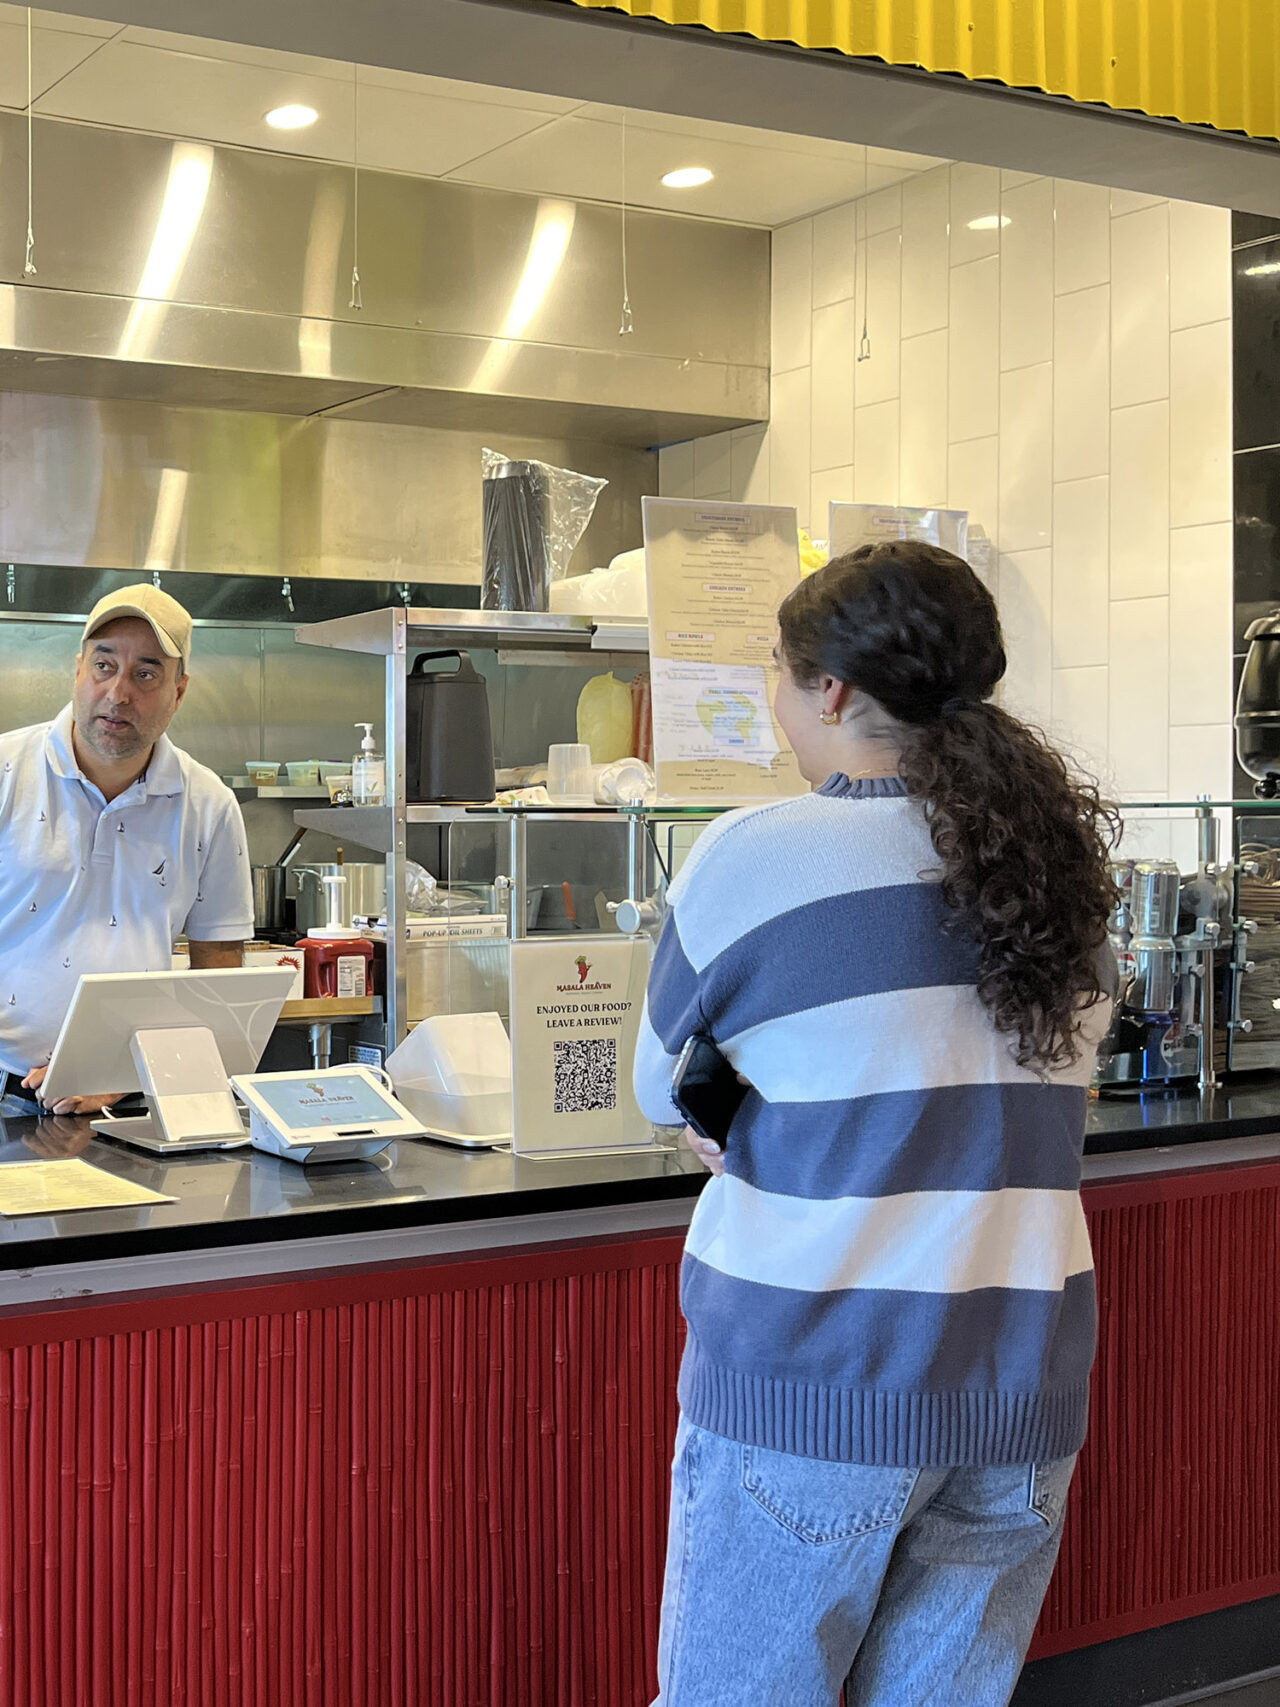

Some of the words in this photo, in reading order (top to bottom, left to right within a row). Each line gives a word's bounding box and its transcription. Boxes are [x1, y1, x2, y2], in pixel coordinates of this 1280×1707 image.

[556, 984, 584, 992] MASALA
[585, 982, 612, 990] HEAVEN
[536, 1004, 579, 1014] ENJOYED
[580, 1003, 600, 1012] OUR
[601, 1002, 632, 1011] FOOD?
[546, 1018, 575, 1028] LEAVE
[576, 1018, 583, 1027] A
[584, 1016, 623, 1026] REVIEW!
